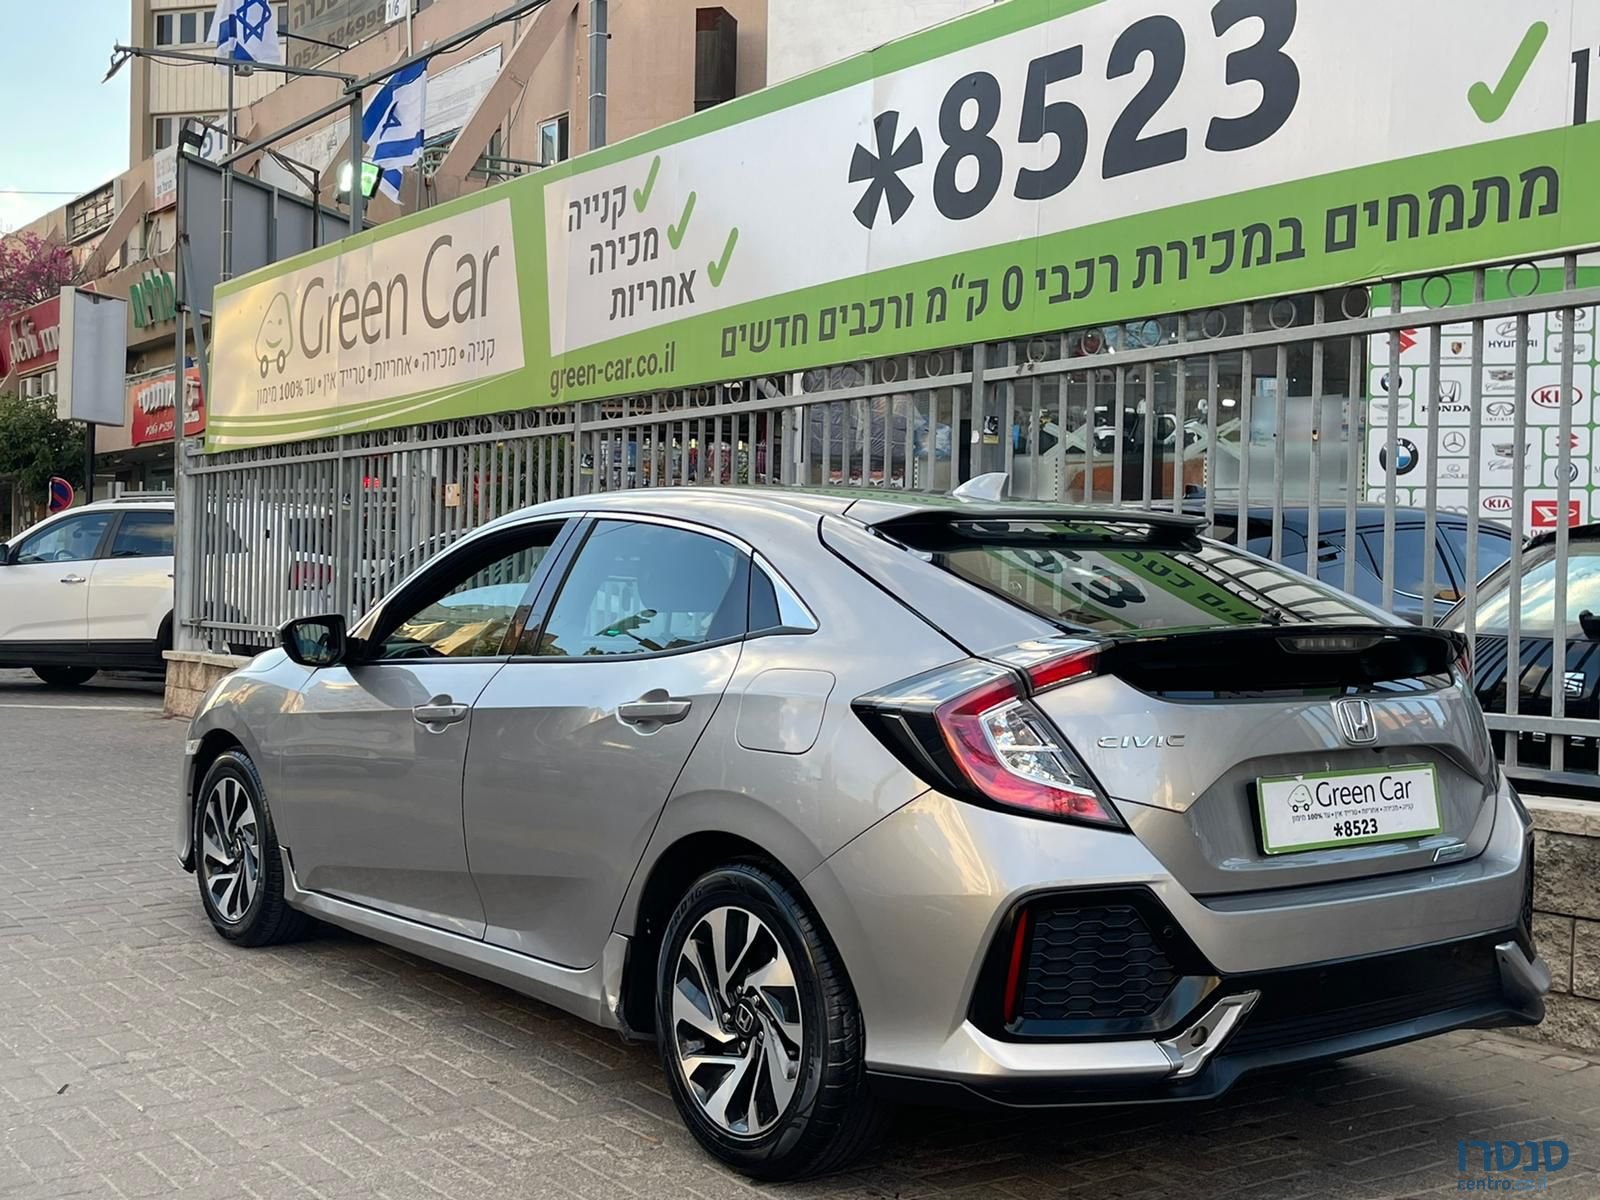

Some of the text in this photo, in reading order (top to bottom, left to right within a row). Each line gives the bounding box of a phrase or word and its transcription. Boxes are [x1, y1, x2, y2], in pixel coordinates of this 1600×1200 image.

[568, 185, 627, 232] קנייה
[1325, 165, 1559, 254] מתמחים
[589, 227, 659, 275] מכירה
[1132, 216, 1305, 289] במכירת
[299, 234, 500, 360] Green Car
[609, 269, 697, 320] אחריות
[1003, 265, 1024, 312] 0
[1035, 254, 1119, 305] רכבי
[721, 313, 808, 358] חדשים
[818, 292, 914, 342] ורכבים
[373, 354, 413, 381] אחריות
[421, 346, 457, 372] מכירה
[467, 338, 495, 366] קניה
[550, 341, 676, 398] green-car.co.il
[279, 379, 304, 401] 100%
[1488, 499, 1511, 509] KIA
[1097, 734, 1186, 749] CIVIC
[1315, 776, 1412, 808] Green Car
